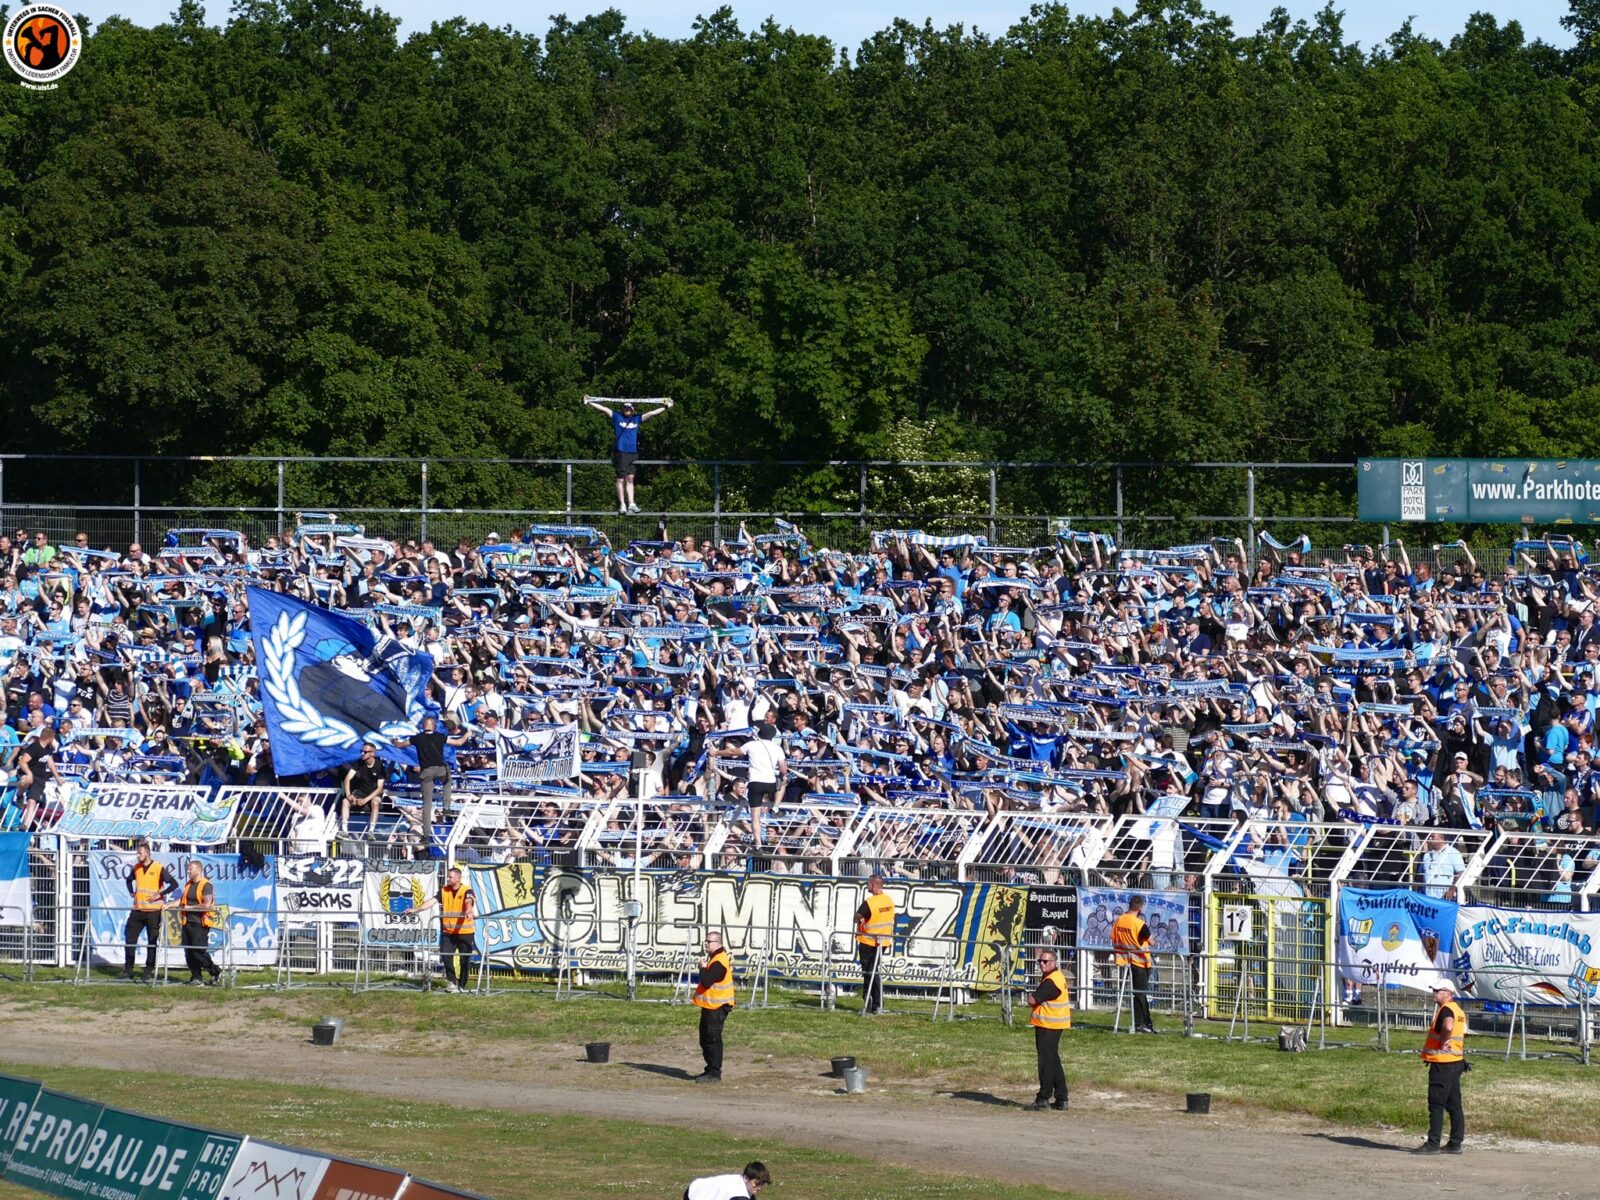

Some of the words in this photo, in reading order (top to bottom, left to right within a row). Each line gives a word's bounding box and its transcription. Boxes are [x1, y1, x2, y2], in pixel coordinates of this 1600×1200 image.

[1403, 487, 1424, 496] PARK
[1403, 496, 1424, 505] HOTEL
[97, 792, 195, 810] OEDERAN
[131, 809, 150, 820] ist
[57, 811, 227, 841] Himmelblau
[278, 857, 315, 882] KF
[333, 859, 364, 884] 22
[367, 859, 435, 874] ULTRAS
[300, 892, 352, 910] BSKMS
[385, 914, 419, 924] 1999
[1226, 911, 1248, 932] 17
[482, 912, 535, 946] CFC
[1459, 915, 1592, 955] CFC-Fanclub
[210, 1145, 234, 1167] RE
[187, 1169, 221, 1194] PRO
